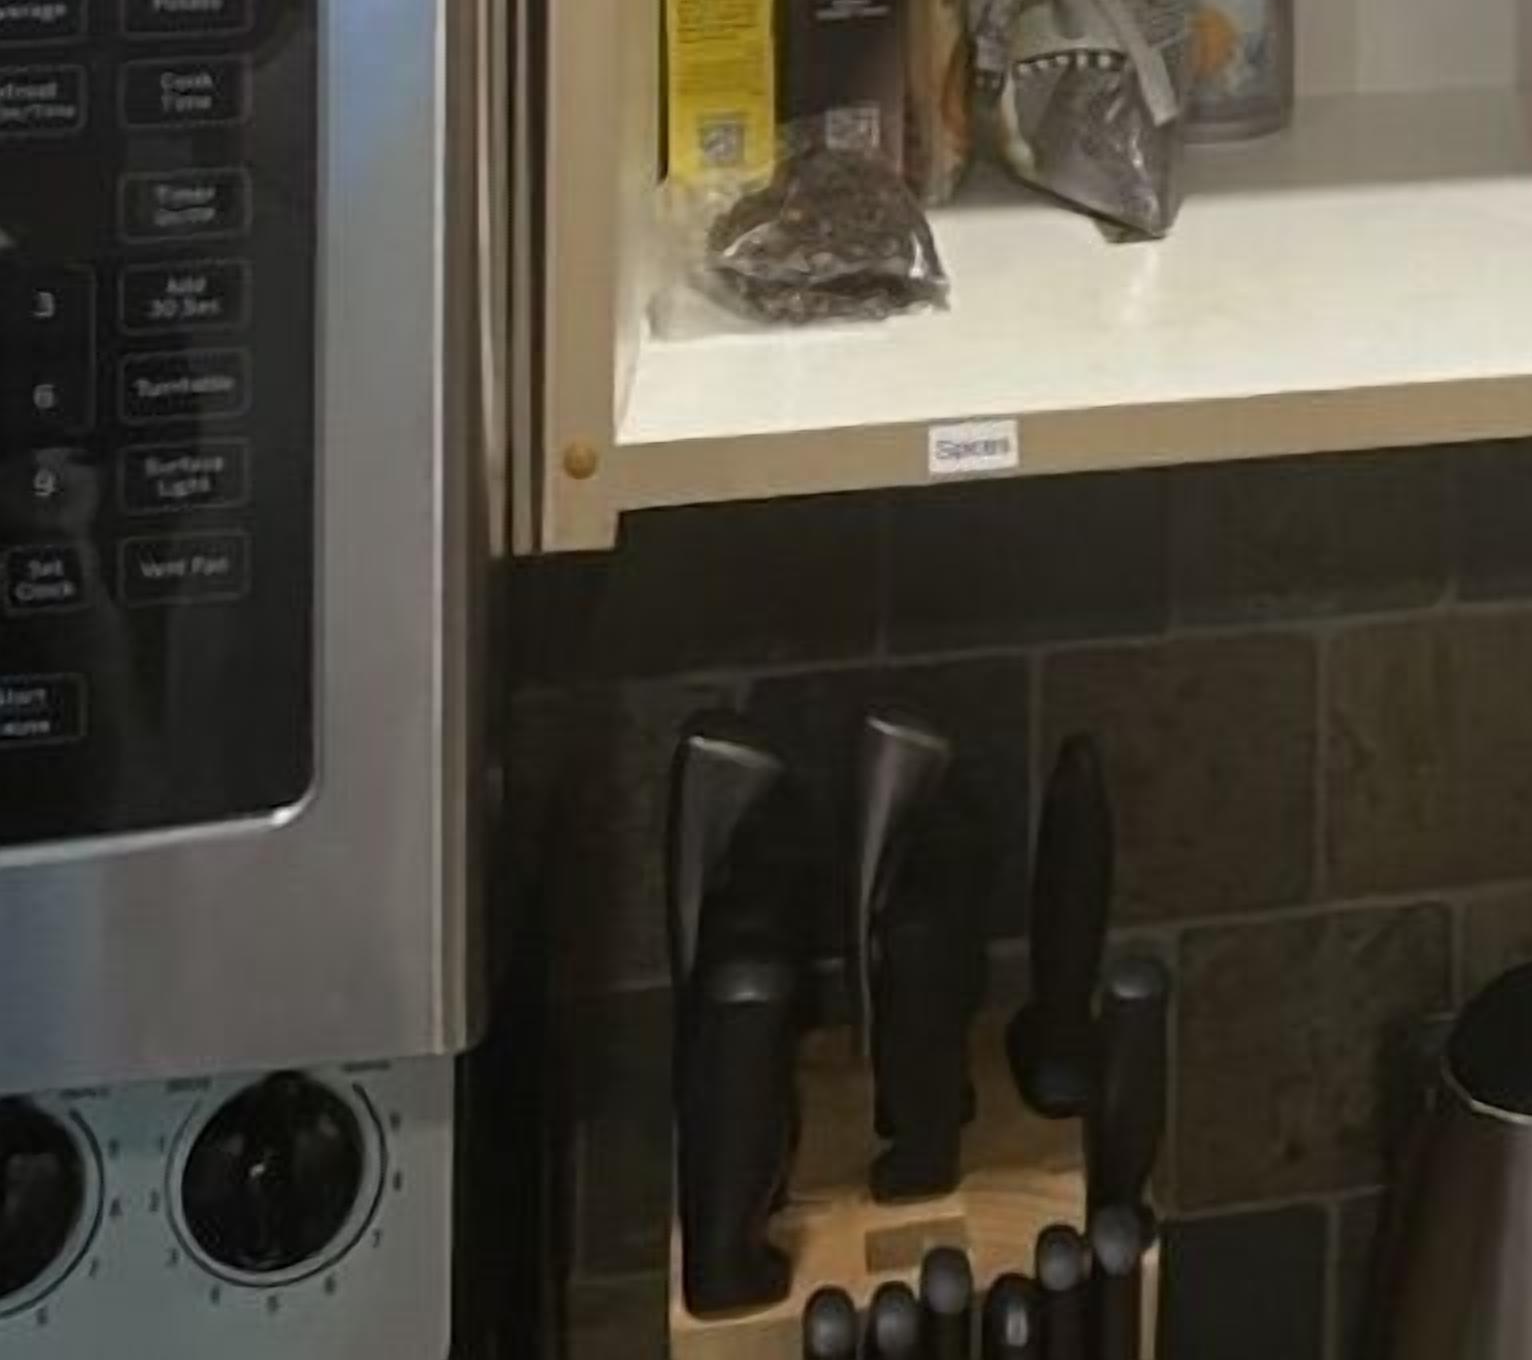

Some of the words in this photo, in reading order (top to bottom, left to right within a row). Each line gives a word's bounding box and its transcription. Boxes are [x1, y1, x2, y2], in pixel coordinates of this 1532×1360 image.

[32, 291, 55, 318] 3
[33, 383, 55, 409] 6
[134, 377, 235, 398] Turntable
[33, 468, 56, 497] 9
[138, 556, 185, 578] Vent
[190, 555, 229, 577] Fan
